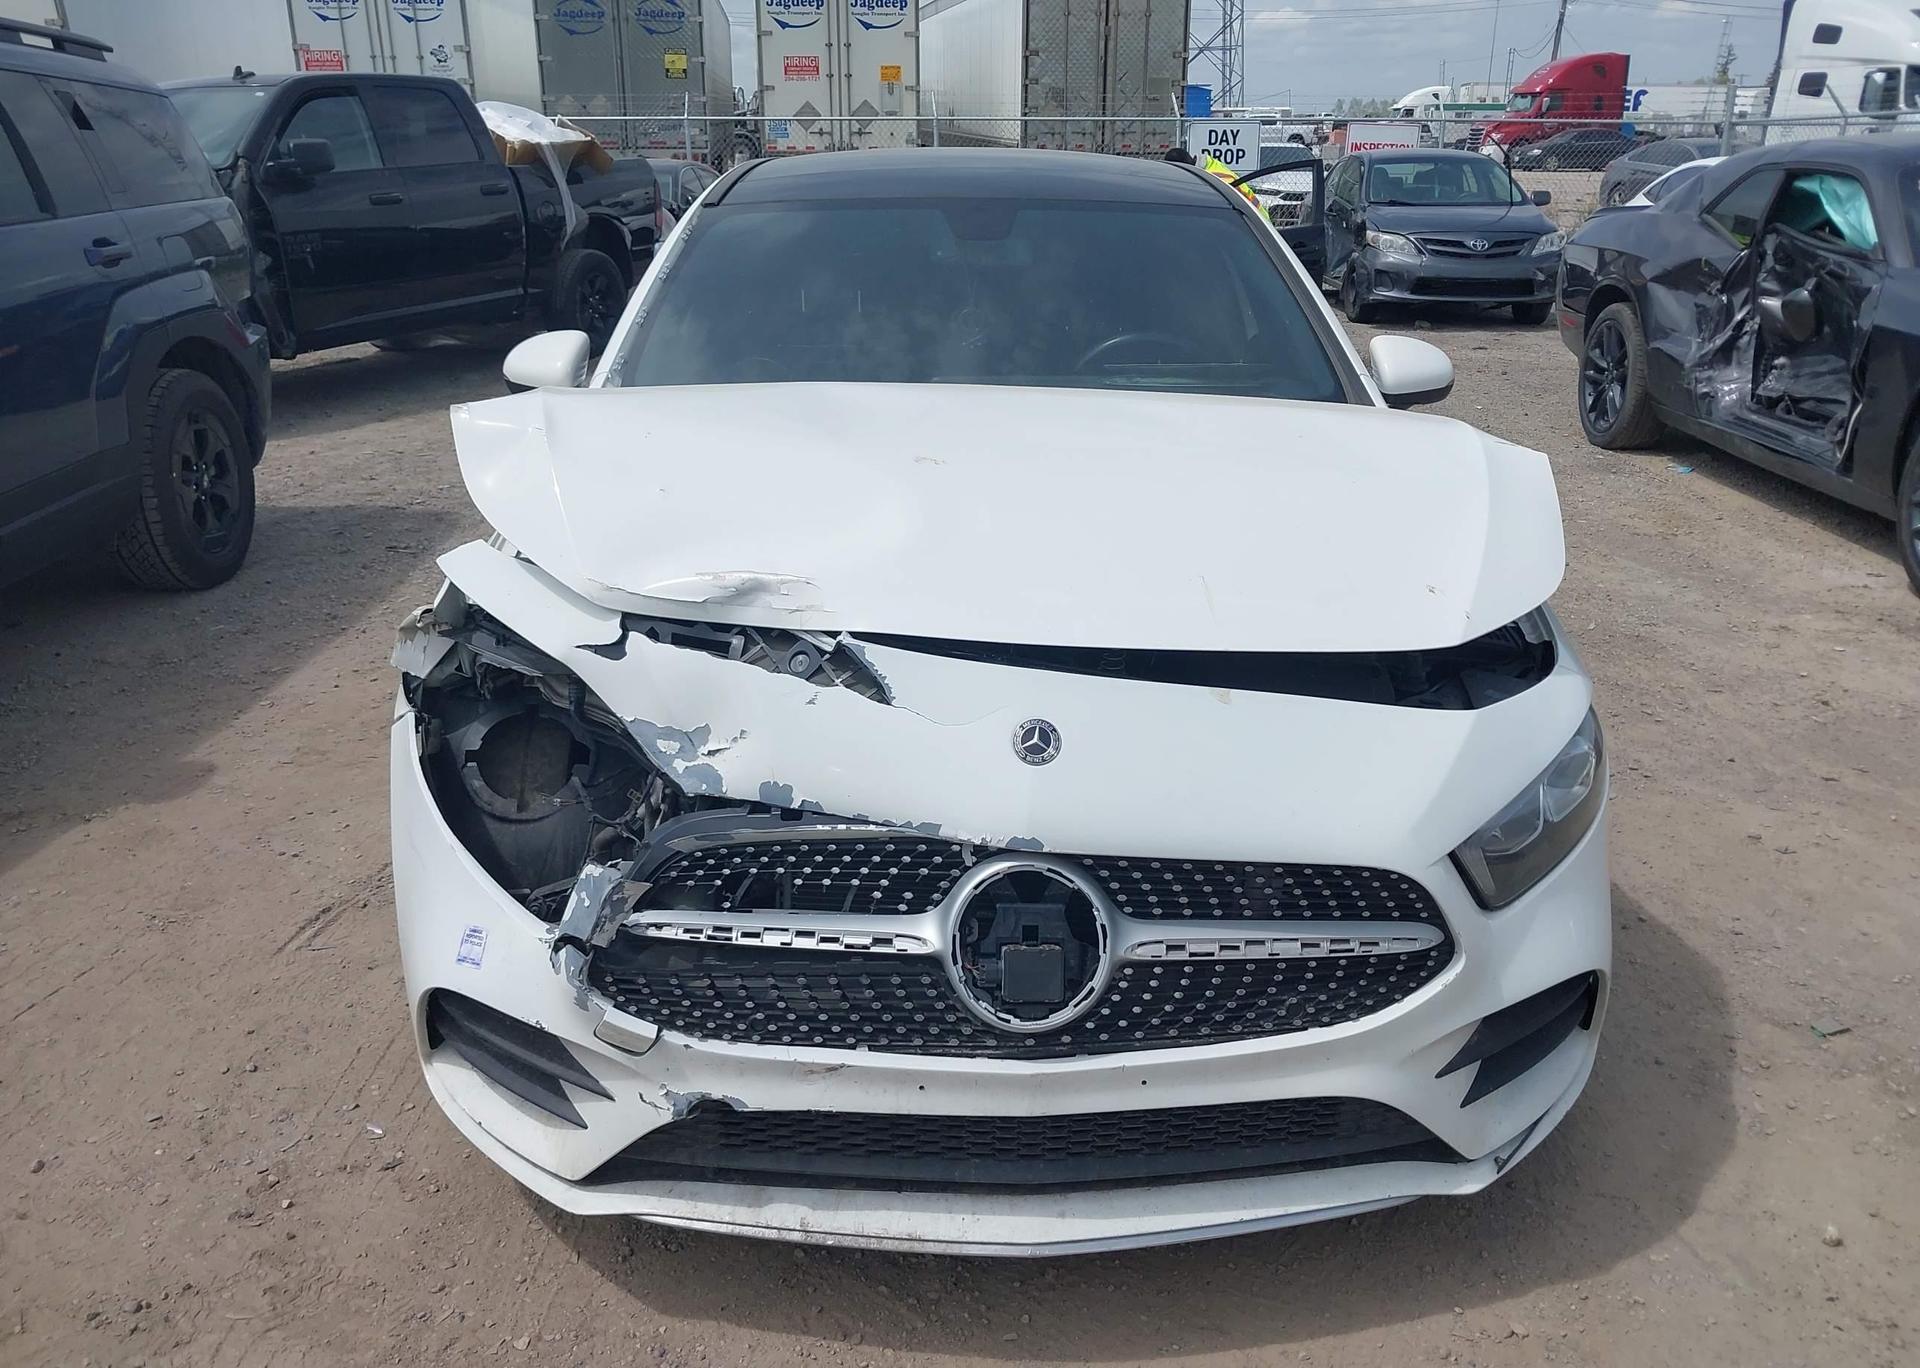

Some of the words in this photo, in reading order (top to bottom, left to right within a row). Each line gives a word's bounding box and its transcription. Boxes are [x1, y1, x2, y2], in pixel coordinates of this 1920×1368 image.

[766, 0, 824, 10] Jagdeep
[850, 0, 908, 11] Jagdeep
[553, 8, 604, 19] Jagdeep
[634, 8, 685, 19] Jagdeep
[304, 51, 342, 61] HIRING!
[784, 56, 819, 66] HIRING!
[1208, 129, 1240, 146] DAY
